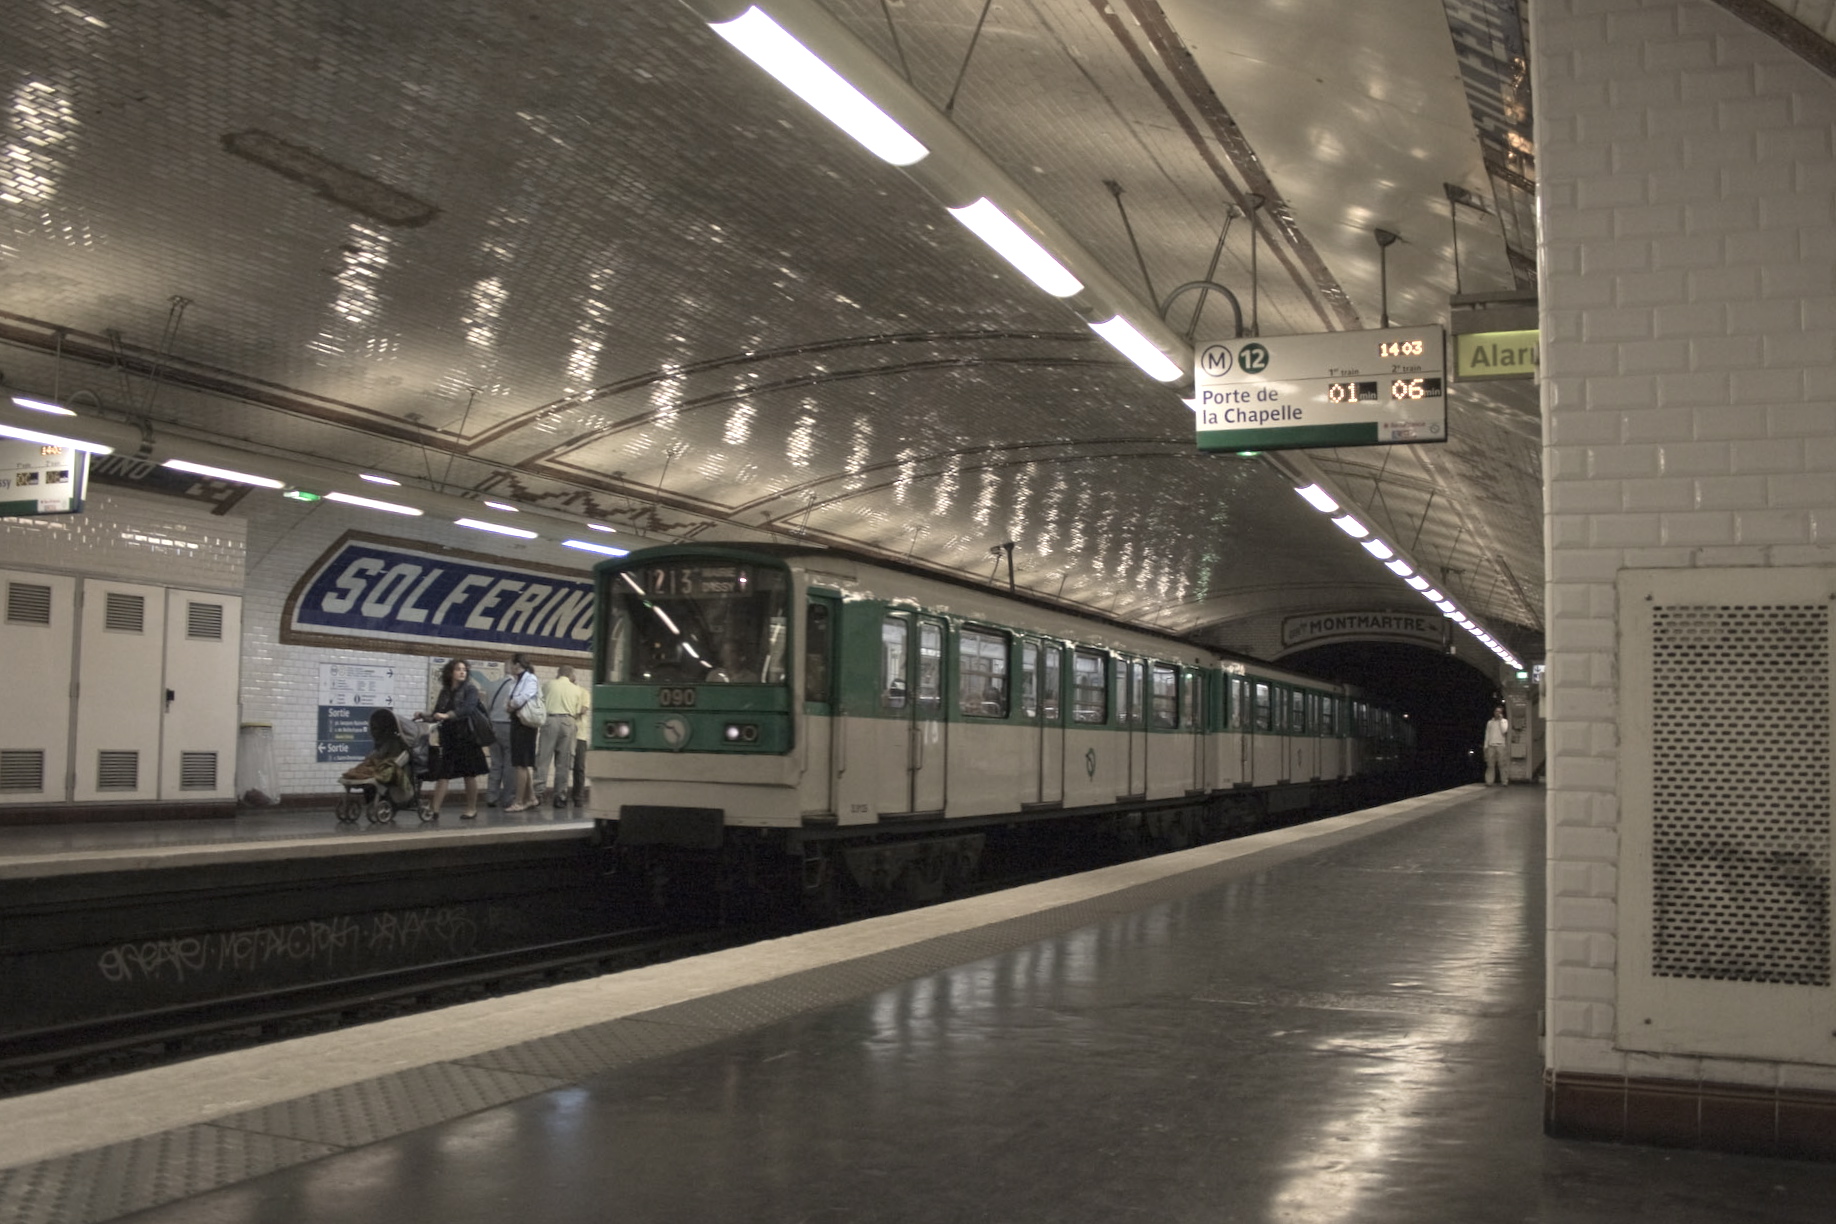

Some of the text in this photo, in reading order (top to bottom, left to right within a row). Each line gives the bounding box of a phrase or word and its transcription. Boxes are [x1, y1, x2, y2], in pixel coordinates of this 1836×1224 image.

[1240, 348, 1266, 369] 12
[1403, 364, 1422, 372] train
[1203, 386, 1279, 405] Porte de
[1329, 382, 1358, 403] 01
[1392, 378, 1424, 399] 06
[1203, 404, 1303, 426] la Chapelle
[1309, 616, 1426, 634] MONTMARTRE
[660, 689, 695, 706] 090
[328, 707, 350, 718] Sortie
[327, 742, 349, 753] Sortie
